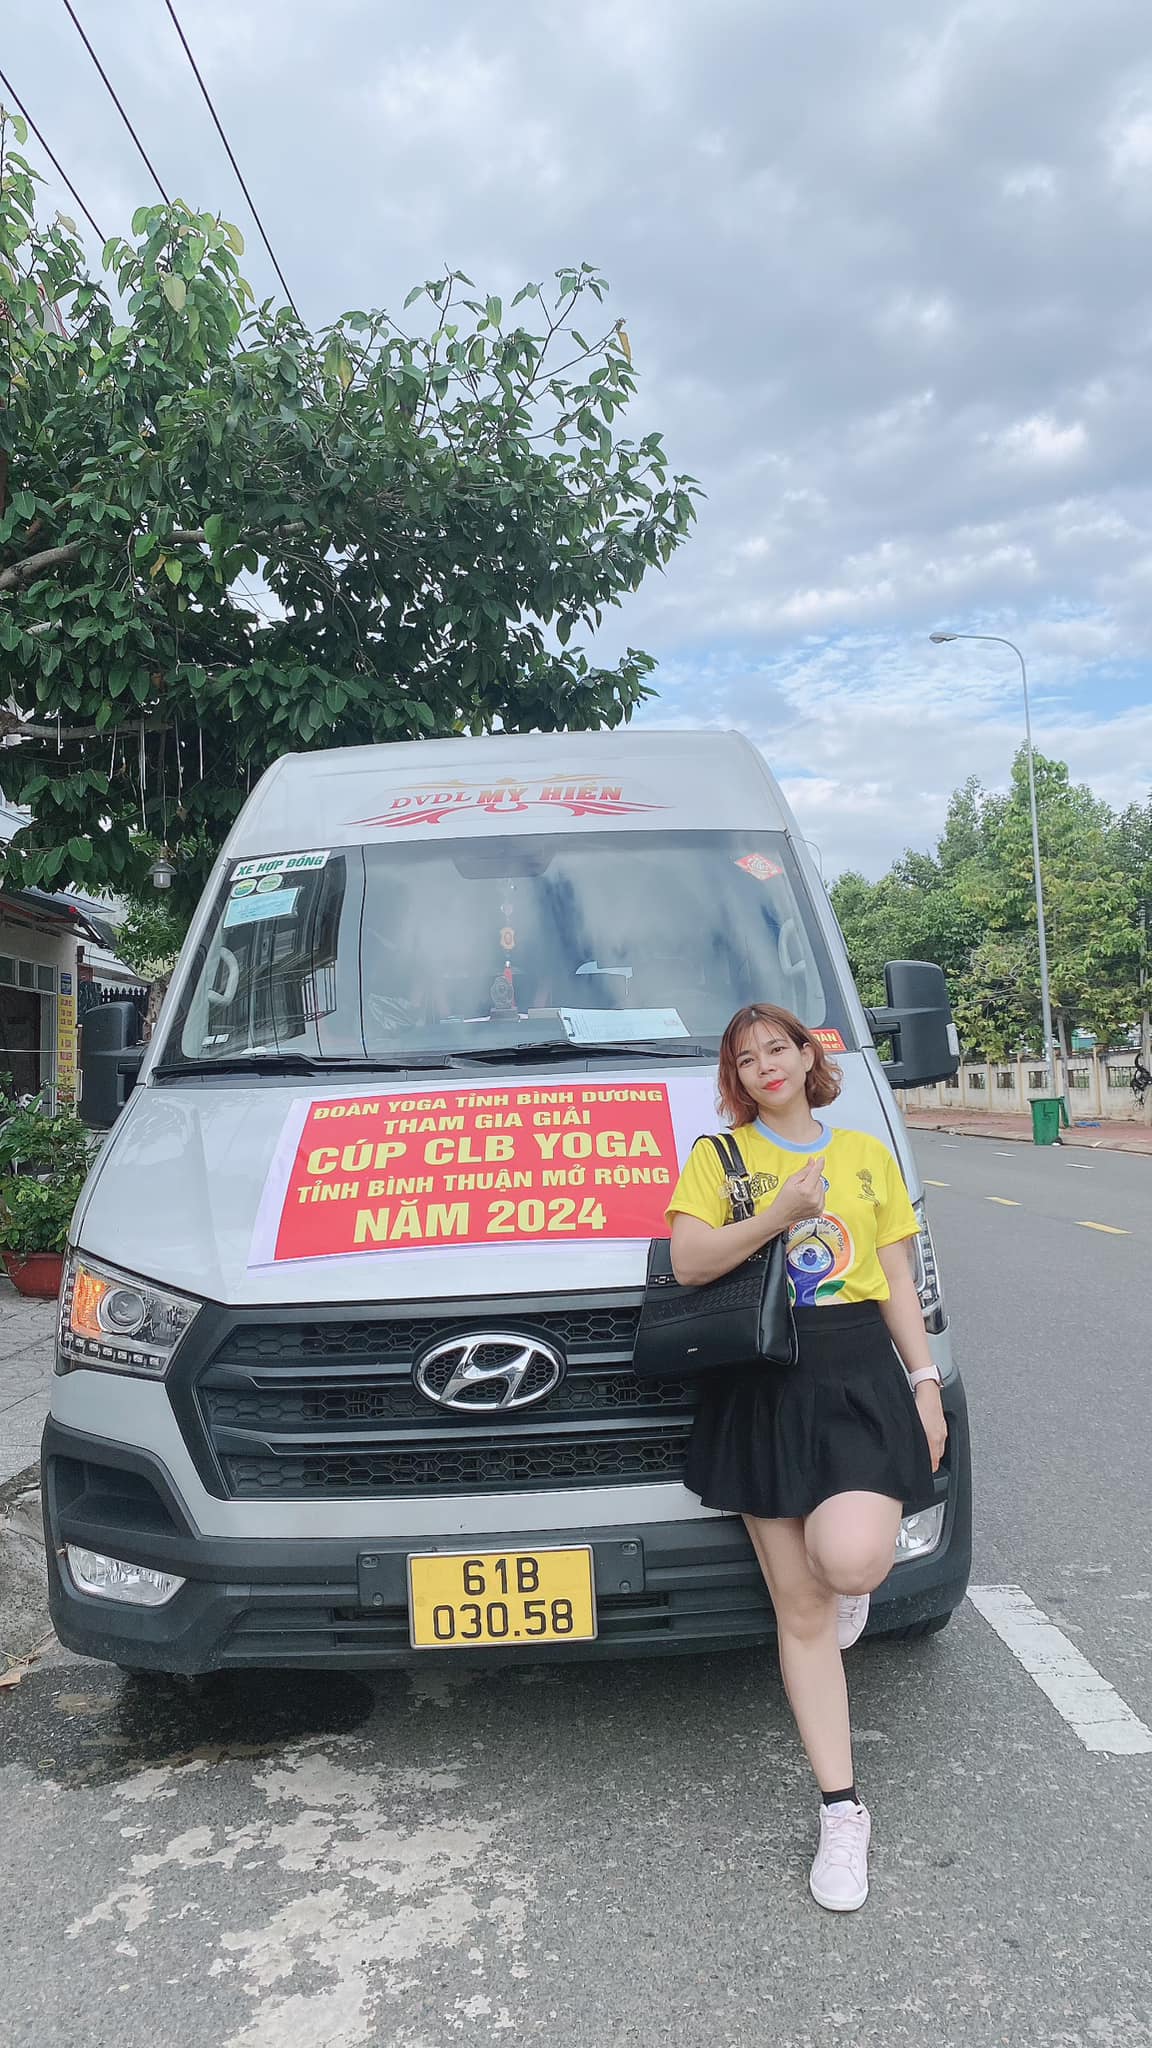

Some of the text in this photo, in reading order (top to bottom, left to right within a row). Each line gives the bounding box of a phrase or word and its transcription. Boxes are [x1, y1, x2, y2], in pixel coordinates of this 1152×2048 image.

[389, 791, 473, 809] DVDL
[237, 865, 254, 876] XE
[313, 1089, 663, 1120] ĐOÀN YOGA TỈNH BÌNH DƯƠNG
[384, 1106, 591, 1135] THAM GIA GIẢI
[306, 1130, 663, 1175] CÚP CLB YOGA
[297, 1163, 671, 1204] TỈNH BÌNH THUẬN MỞ RỘNG
[353, 1197, 608, 1244] NĂM 2024
[462, 1556, 540, 1597] 61B
[432, 1598, 574, 1640] 030.58
